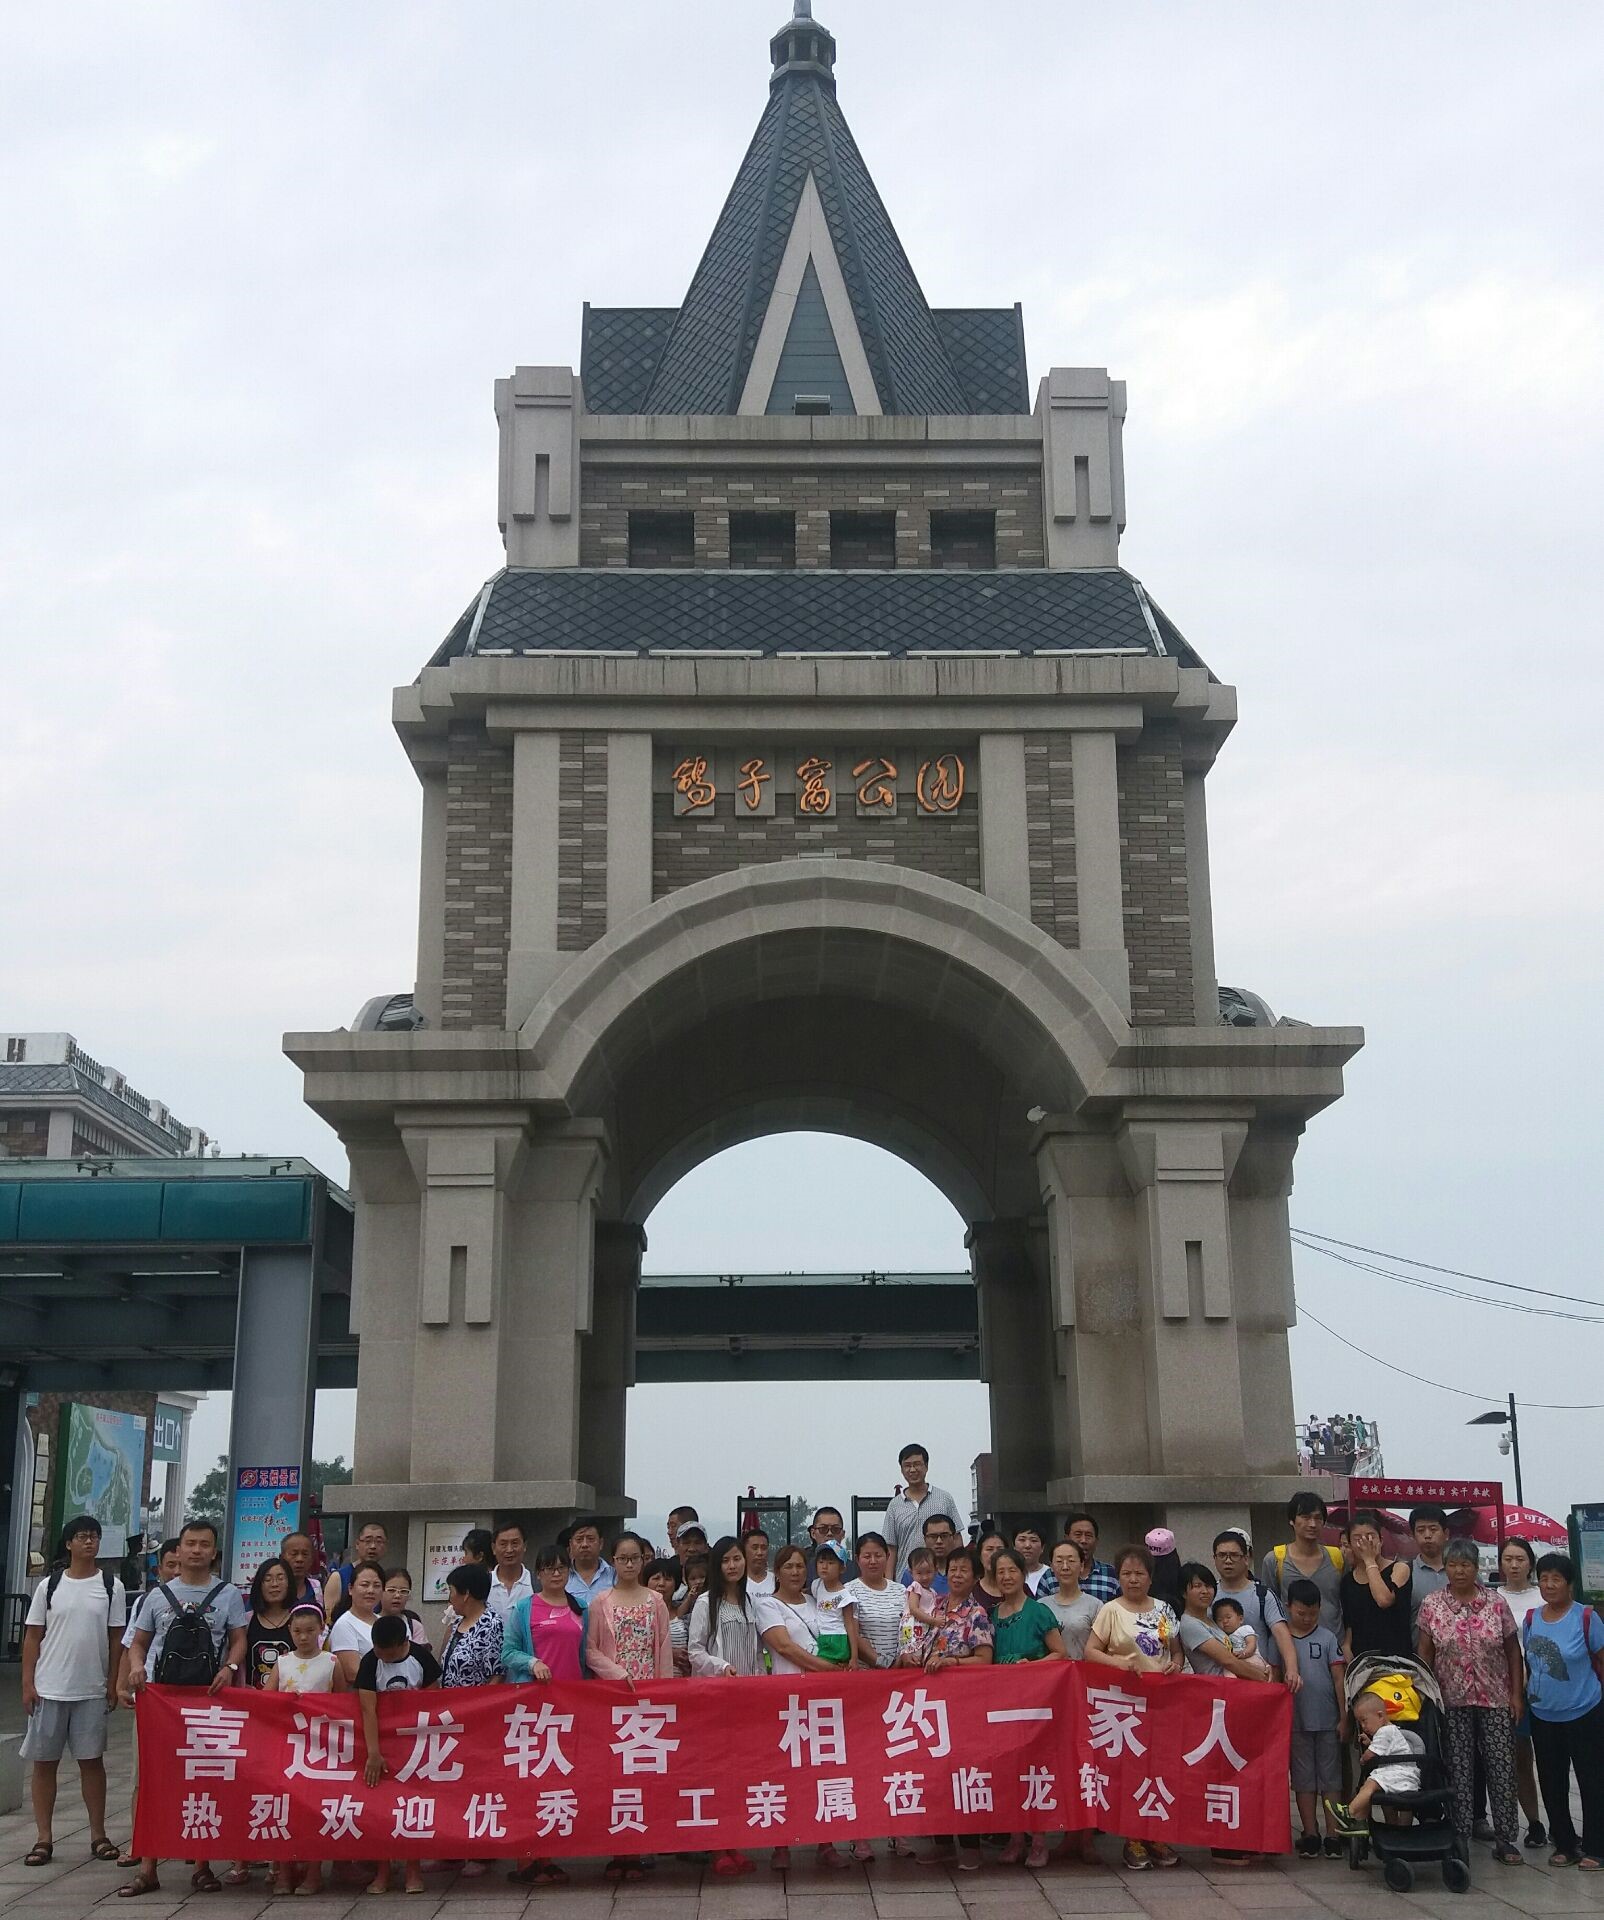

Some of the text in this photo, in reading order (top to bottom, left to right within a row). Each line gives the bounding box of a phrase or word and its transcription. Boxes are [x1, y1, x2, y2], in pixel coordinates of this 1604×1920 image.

[154, 1414, 175, 1450] 出口
[259, 1469, 298, 1487] 无烟景区
[1361, 1484, 1380, 1495] 忠诚
[1383, 1485, 1402, 1495] 仁爱
[1427, 1486, 1446, 1497] 担当
[1450, 1486, 1468, 1497] 实干
[1472, 1487, 1491, 1498] 奉献
[176, 1684, 1249, 1784] 喜迎龙软客 相约一家人
[181, 1761, 1242, 1841] 热烈欢迎优秀员工亲属莅临龙软公司
